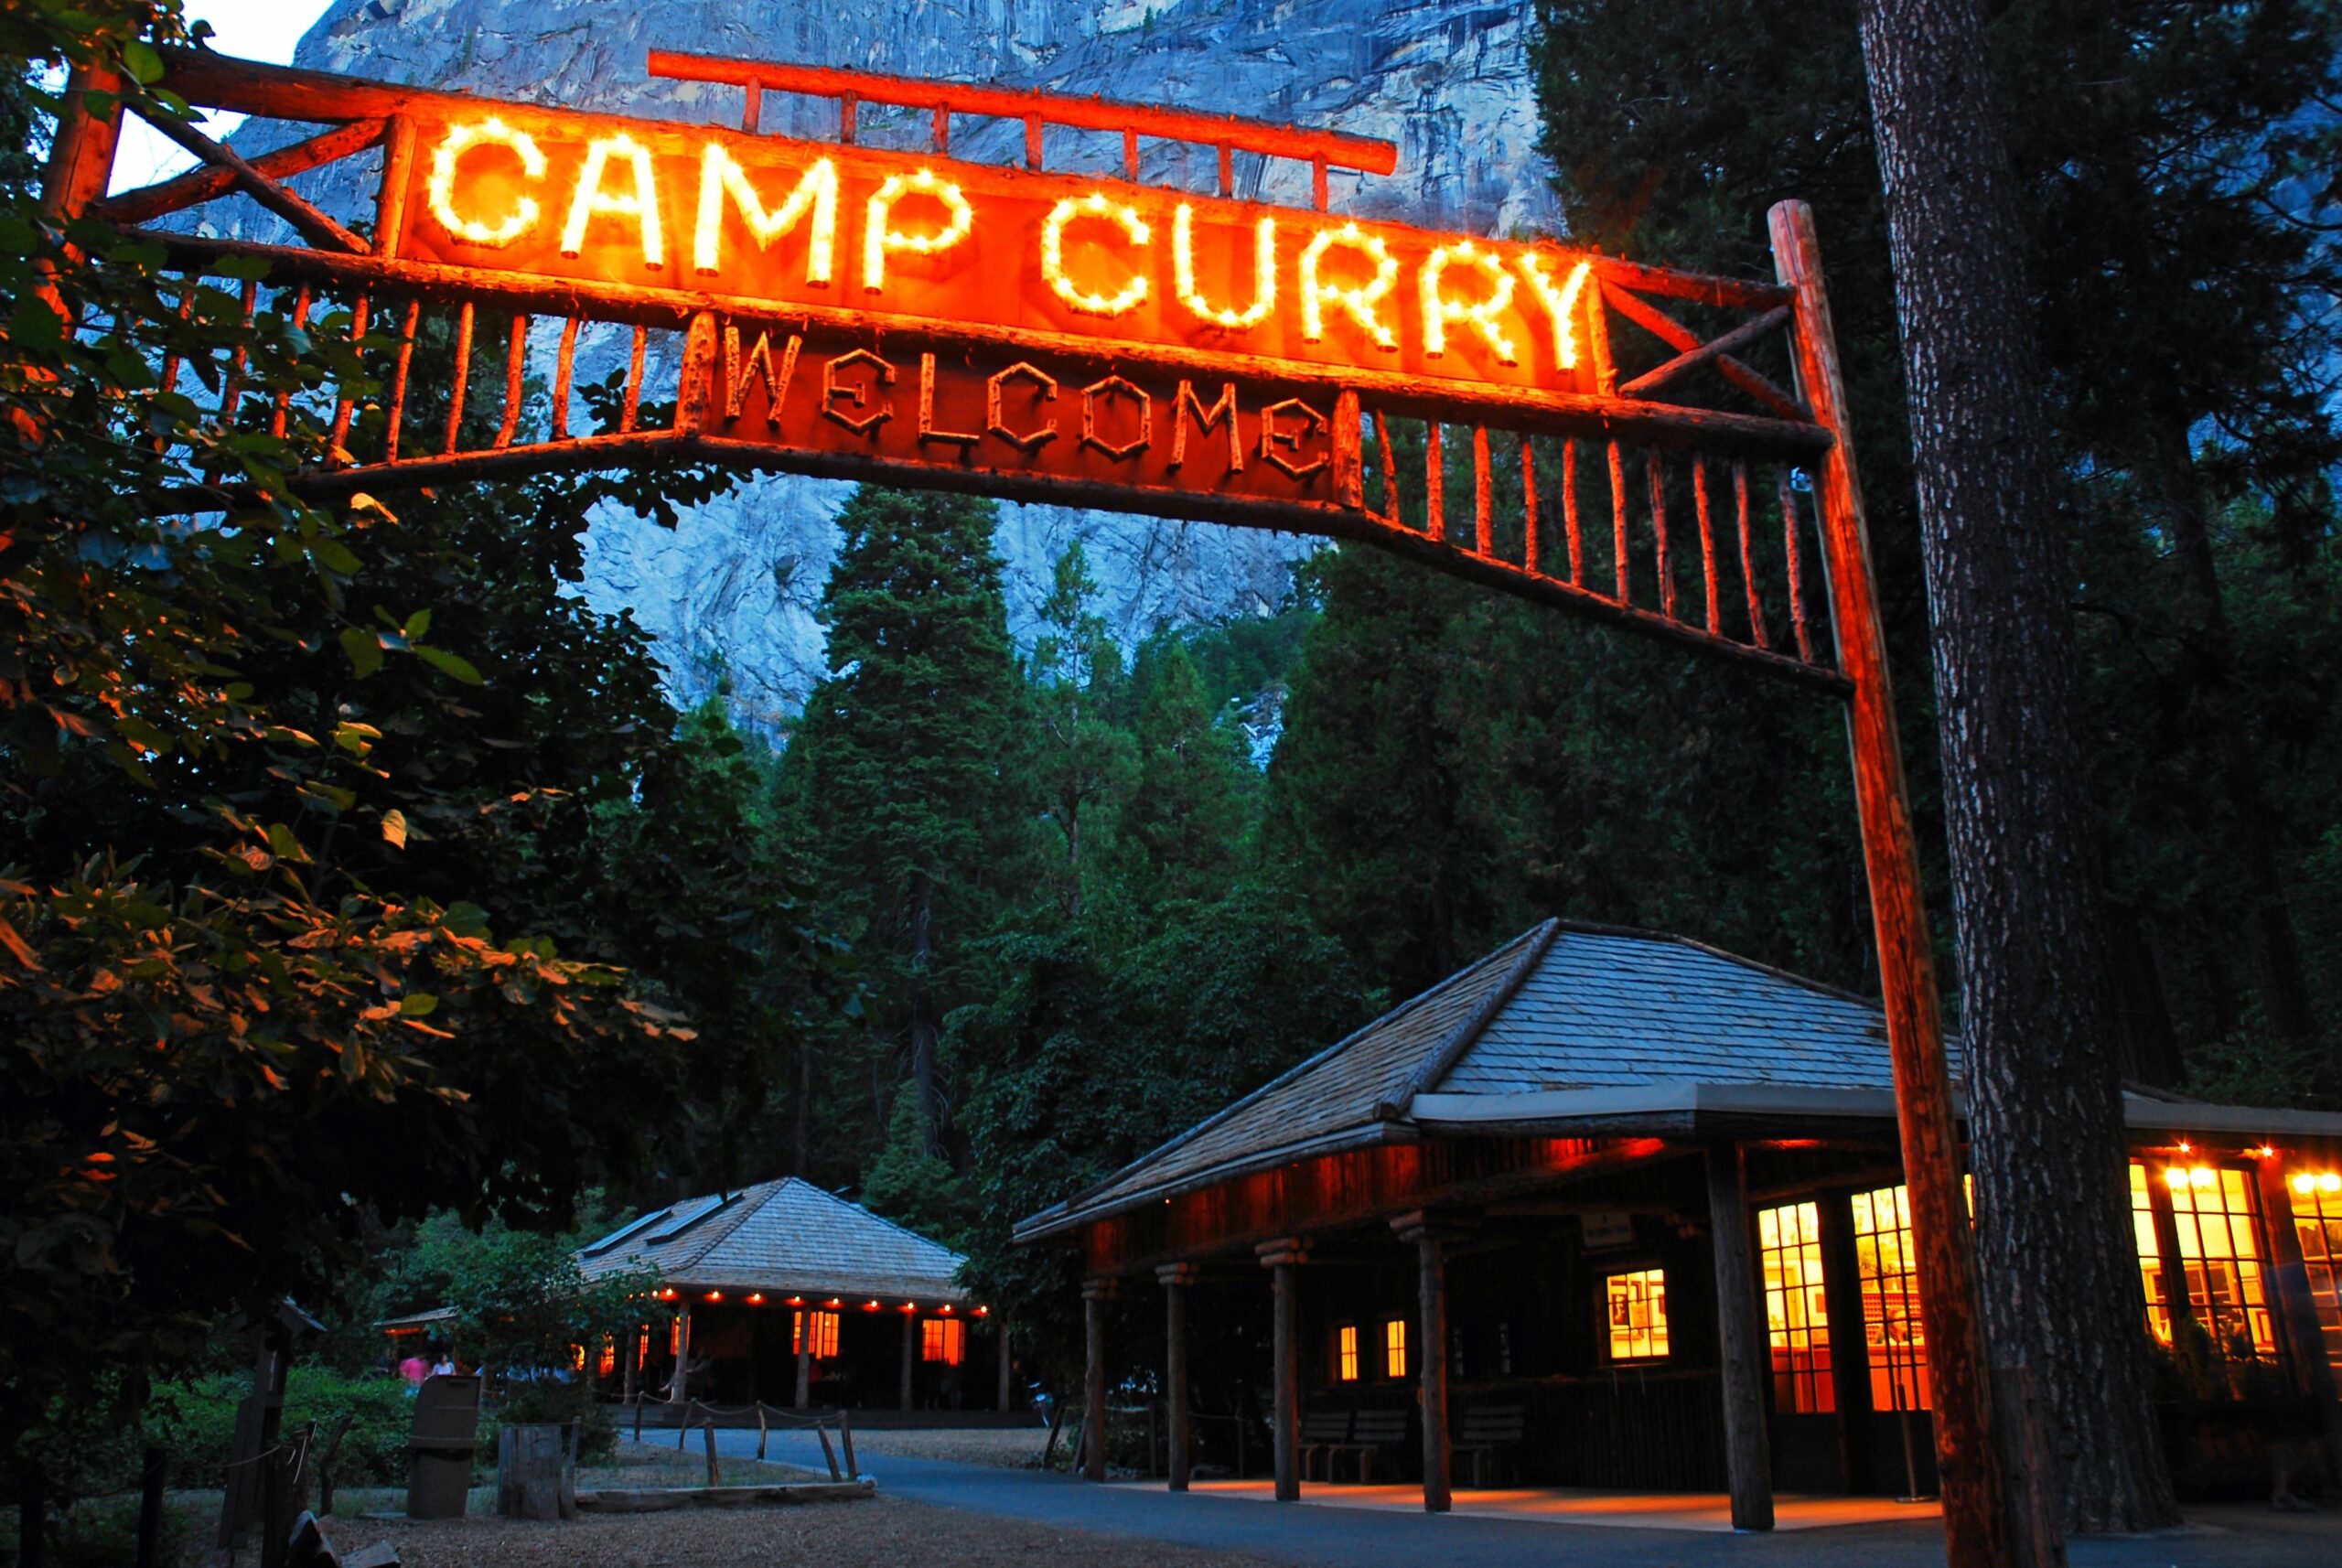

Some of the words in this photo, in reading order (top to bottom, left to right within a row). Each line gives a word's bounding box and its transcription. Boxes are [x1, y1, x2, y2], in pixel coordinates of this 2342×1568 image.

[427, 118, 972, 295] CAMP
[1040, 193, 1590, 373] CURRY
[724, 325, 1330, 480] WELCOME
